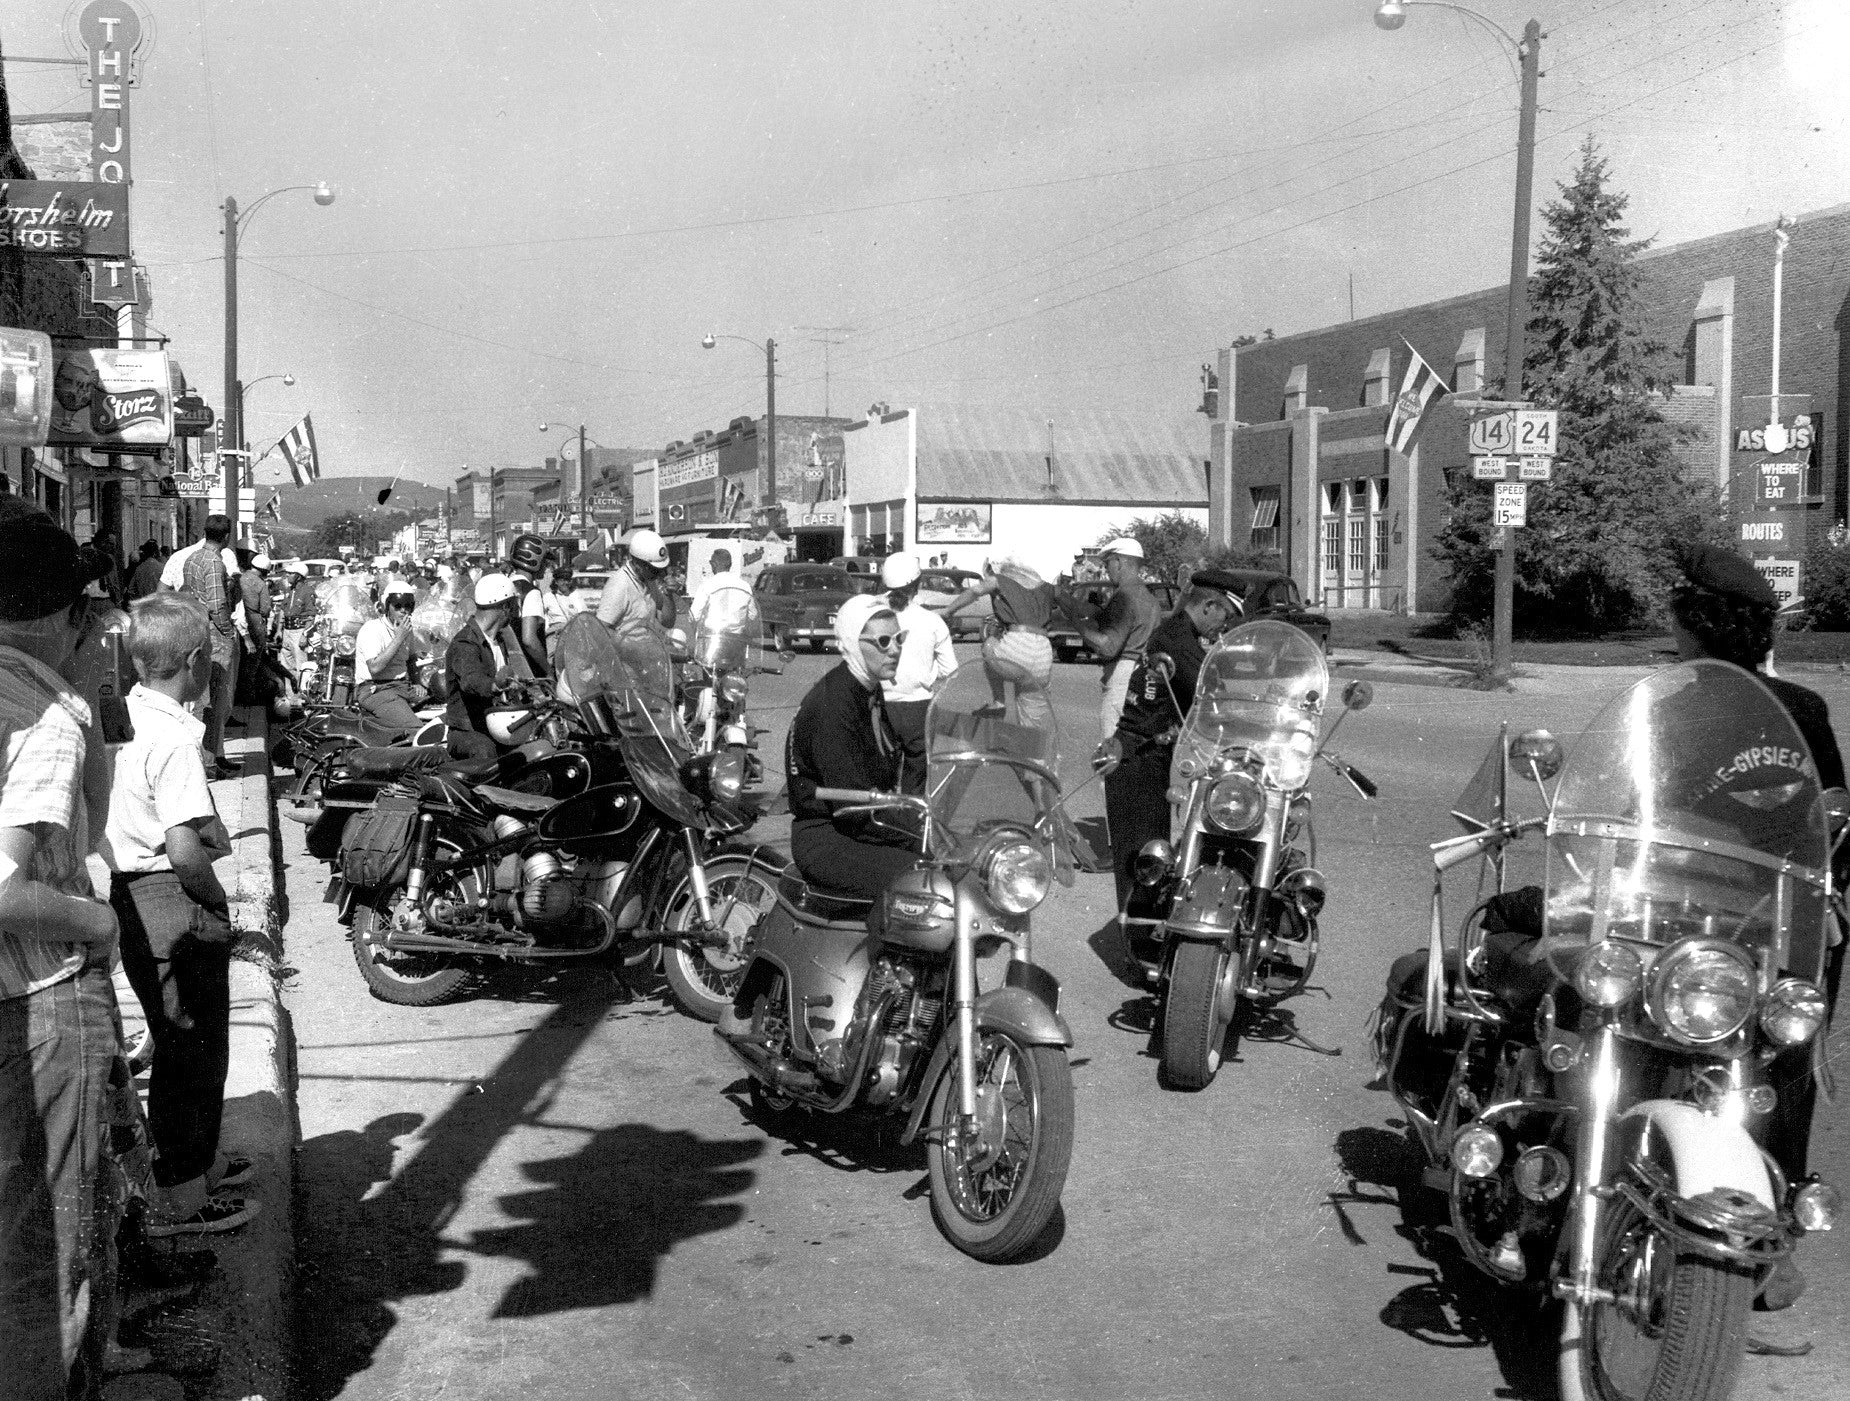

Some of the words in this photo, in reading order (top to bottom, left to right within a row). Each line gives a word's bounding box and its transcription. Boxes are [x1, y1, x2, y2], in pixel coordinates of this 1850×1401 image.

[98, 17, 122, 109] THE
[100, 394, 156, 426] Storz
[1482, 420, 1502, 443] 14
[1522, 421, 1550, 444] 24
[1479, 468, 1502, 476] BOUND
[1760, 463, 1800, 475] WHERE
[1765, 476, 1780, 486] TO
[1497, 486, 1525, 495] SPEED
[1765, 487, 1786, 499] EAT
[1499, 498, 1522, 507] ZONE
[802, 514, 834, 526] CAFE
[1497, 510, 1510, 524] 15
[1741, 523, 1784, 540] ROUTES
